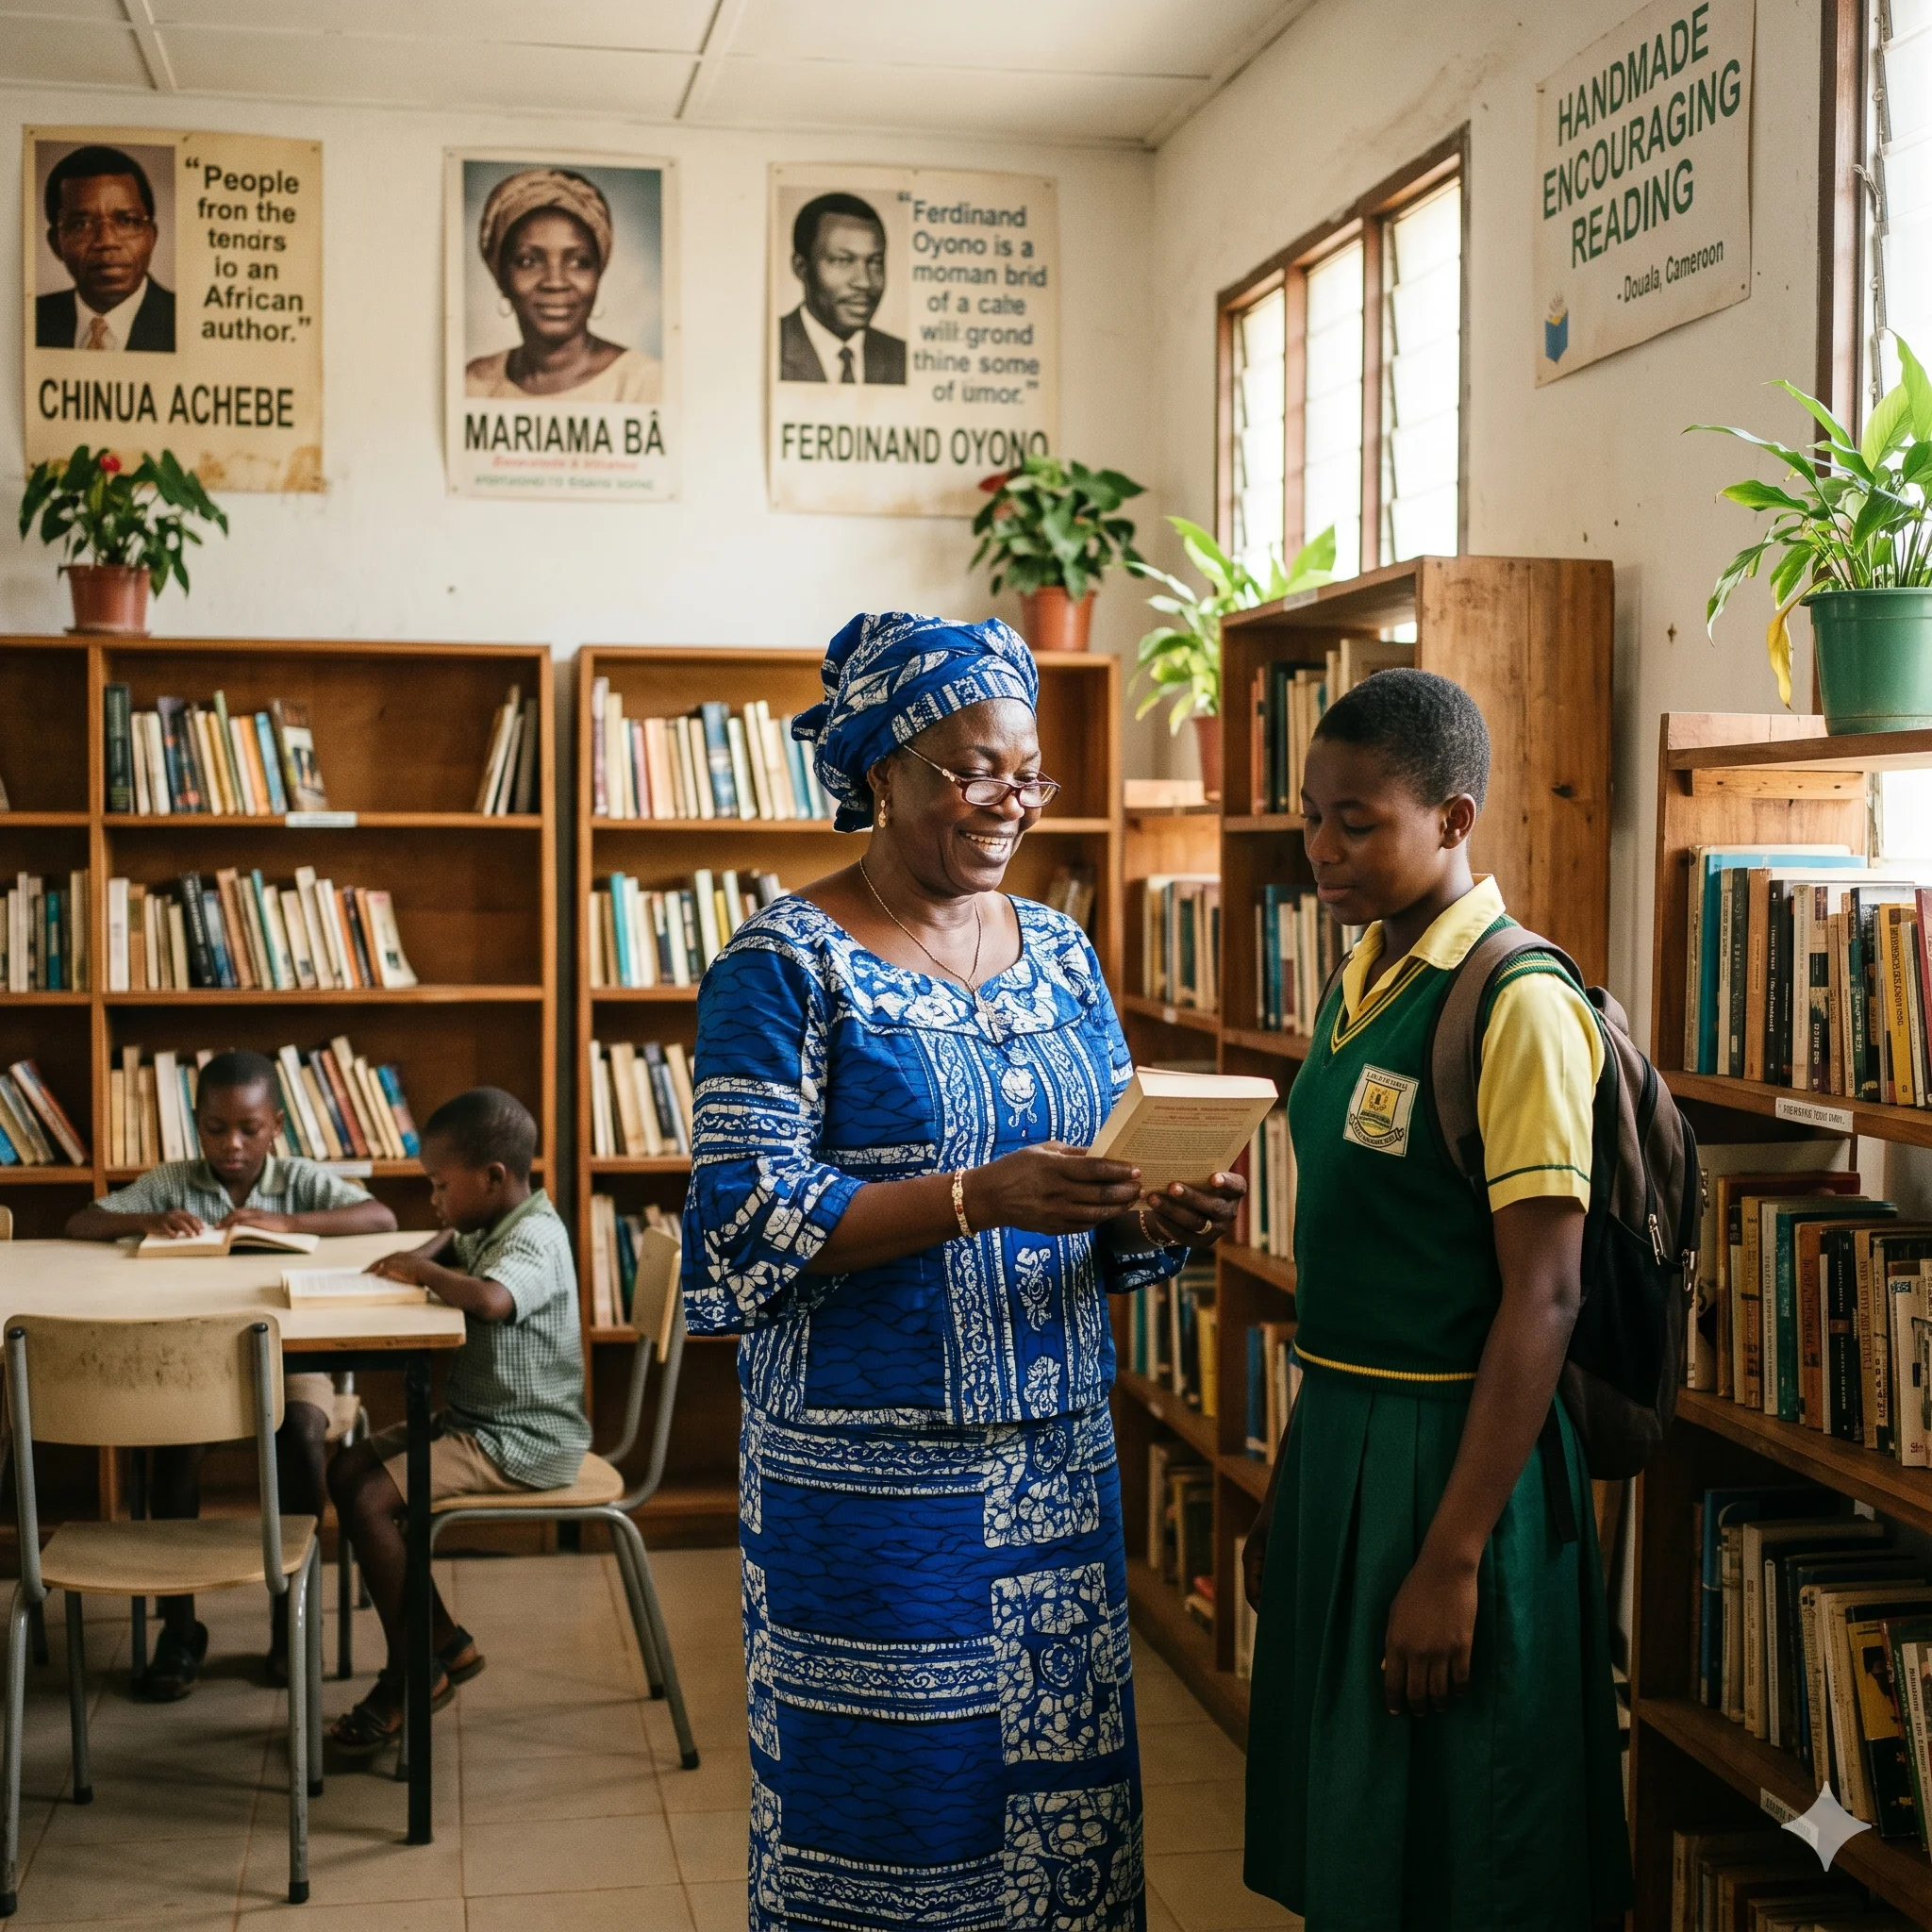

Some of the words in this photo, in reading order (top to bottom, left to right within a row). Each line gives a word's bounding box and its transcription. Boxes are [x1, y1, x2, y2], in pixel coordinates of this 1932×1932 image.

[1557, 2, 1709, 147] HANDMADE
[1543, 58, 1741, 221] ENCOURAGING
[197, 196, 248, 221] fron
[257, 201, 296, 224] the
[1572, 158, 1694, 269] READING
[912, 230, 988, 259] Oyono
[993, 234, 1014, 258] is
[1021, 240, 1035, 258] a
[247, 261, 278, 280] an
[1666, 241, 1724, 284] Cameroon
[203, 285, 304, 312] African
[926, 291, 950, 312] of
[957, 296, 970, 313] a
[978, 356, 1041, 375] some
[39, 378, 158, 424] CHINUA
[168, 383, 294, 427] ACHEBE
[932, 380, 954, 402] of
[464, 413, 613, 455] MARIAMA
[782, 423, 941, 464] FERDINAND
[950, 428, 1049, 467] OYONO
